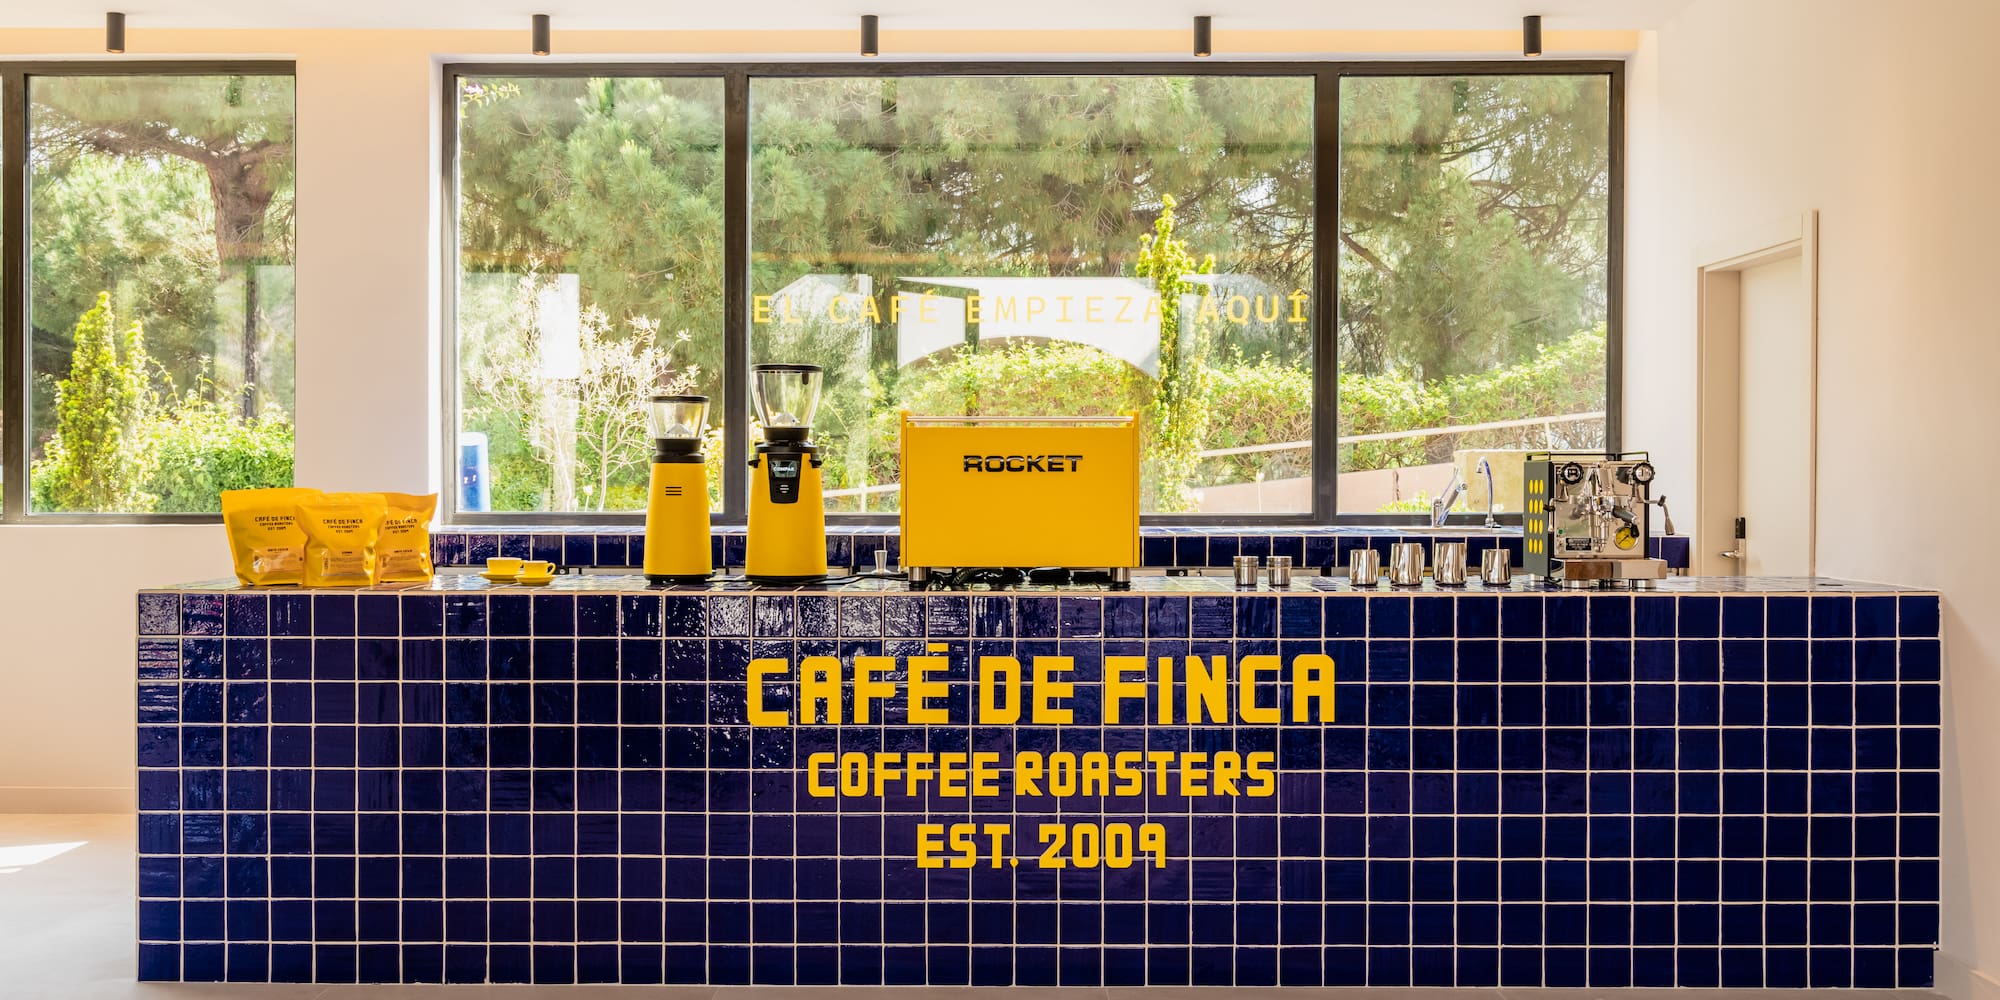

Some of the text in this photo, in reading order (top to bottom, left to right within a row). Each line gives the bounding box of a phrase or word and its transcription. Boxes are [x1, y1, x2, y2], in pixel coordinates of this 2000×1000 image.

[753, 288, 1308, 326] EL CAFÉ EMPIEZA AQUÍ
[963, 455, 1083, 473] ROCKET
[747, 643, 1335, 726] CAFÉ DE FINCA
[808, 751, 1275, 797] COFFEE ROASTERS
[917, 823, 1167, 869] EST. 2009
